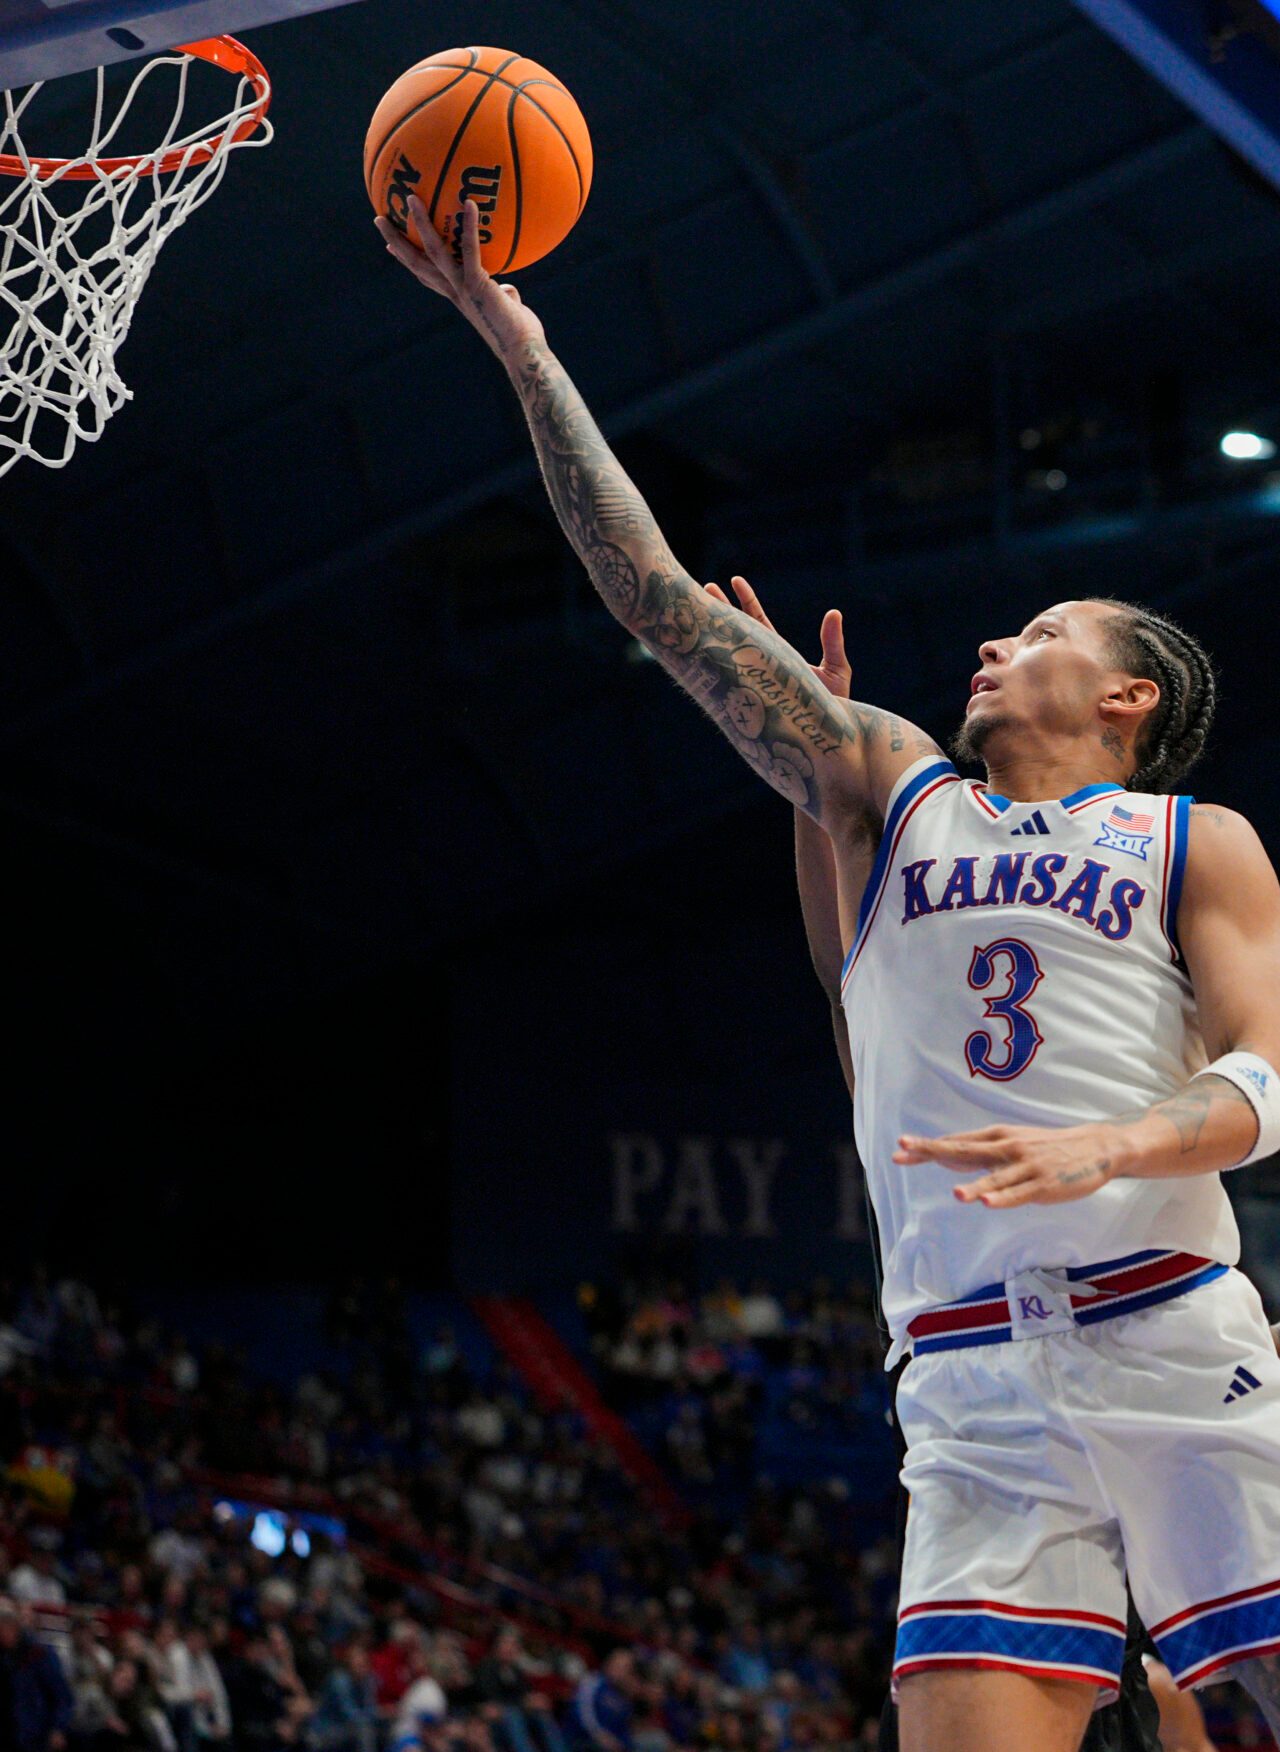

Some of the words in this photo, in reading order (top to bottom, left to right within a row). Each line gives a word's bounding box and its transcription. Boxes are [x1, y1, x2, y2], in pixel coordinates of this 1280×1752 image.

[731, 643, 842, 756] Consistent
[901, 850, 1146, 941] KANSAS
[964, 937, 1045, 1082] 3
[606, 1132, 785, 1238] PAY
